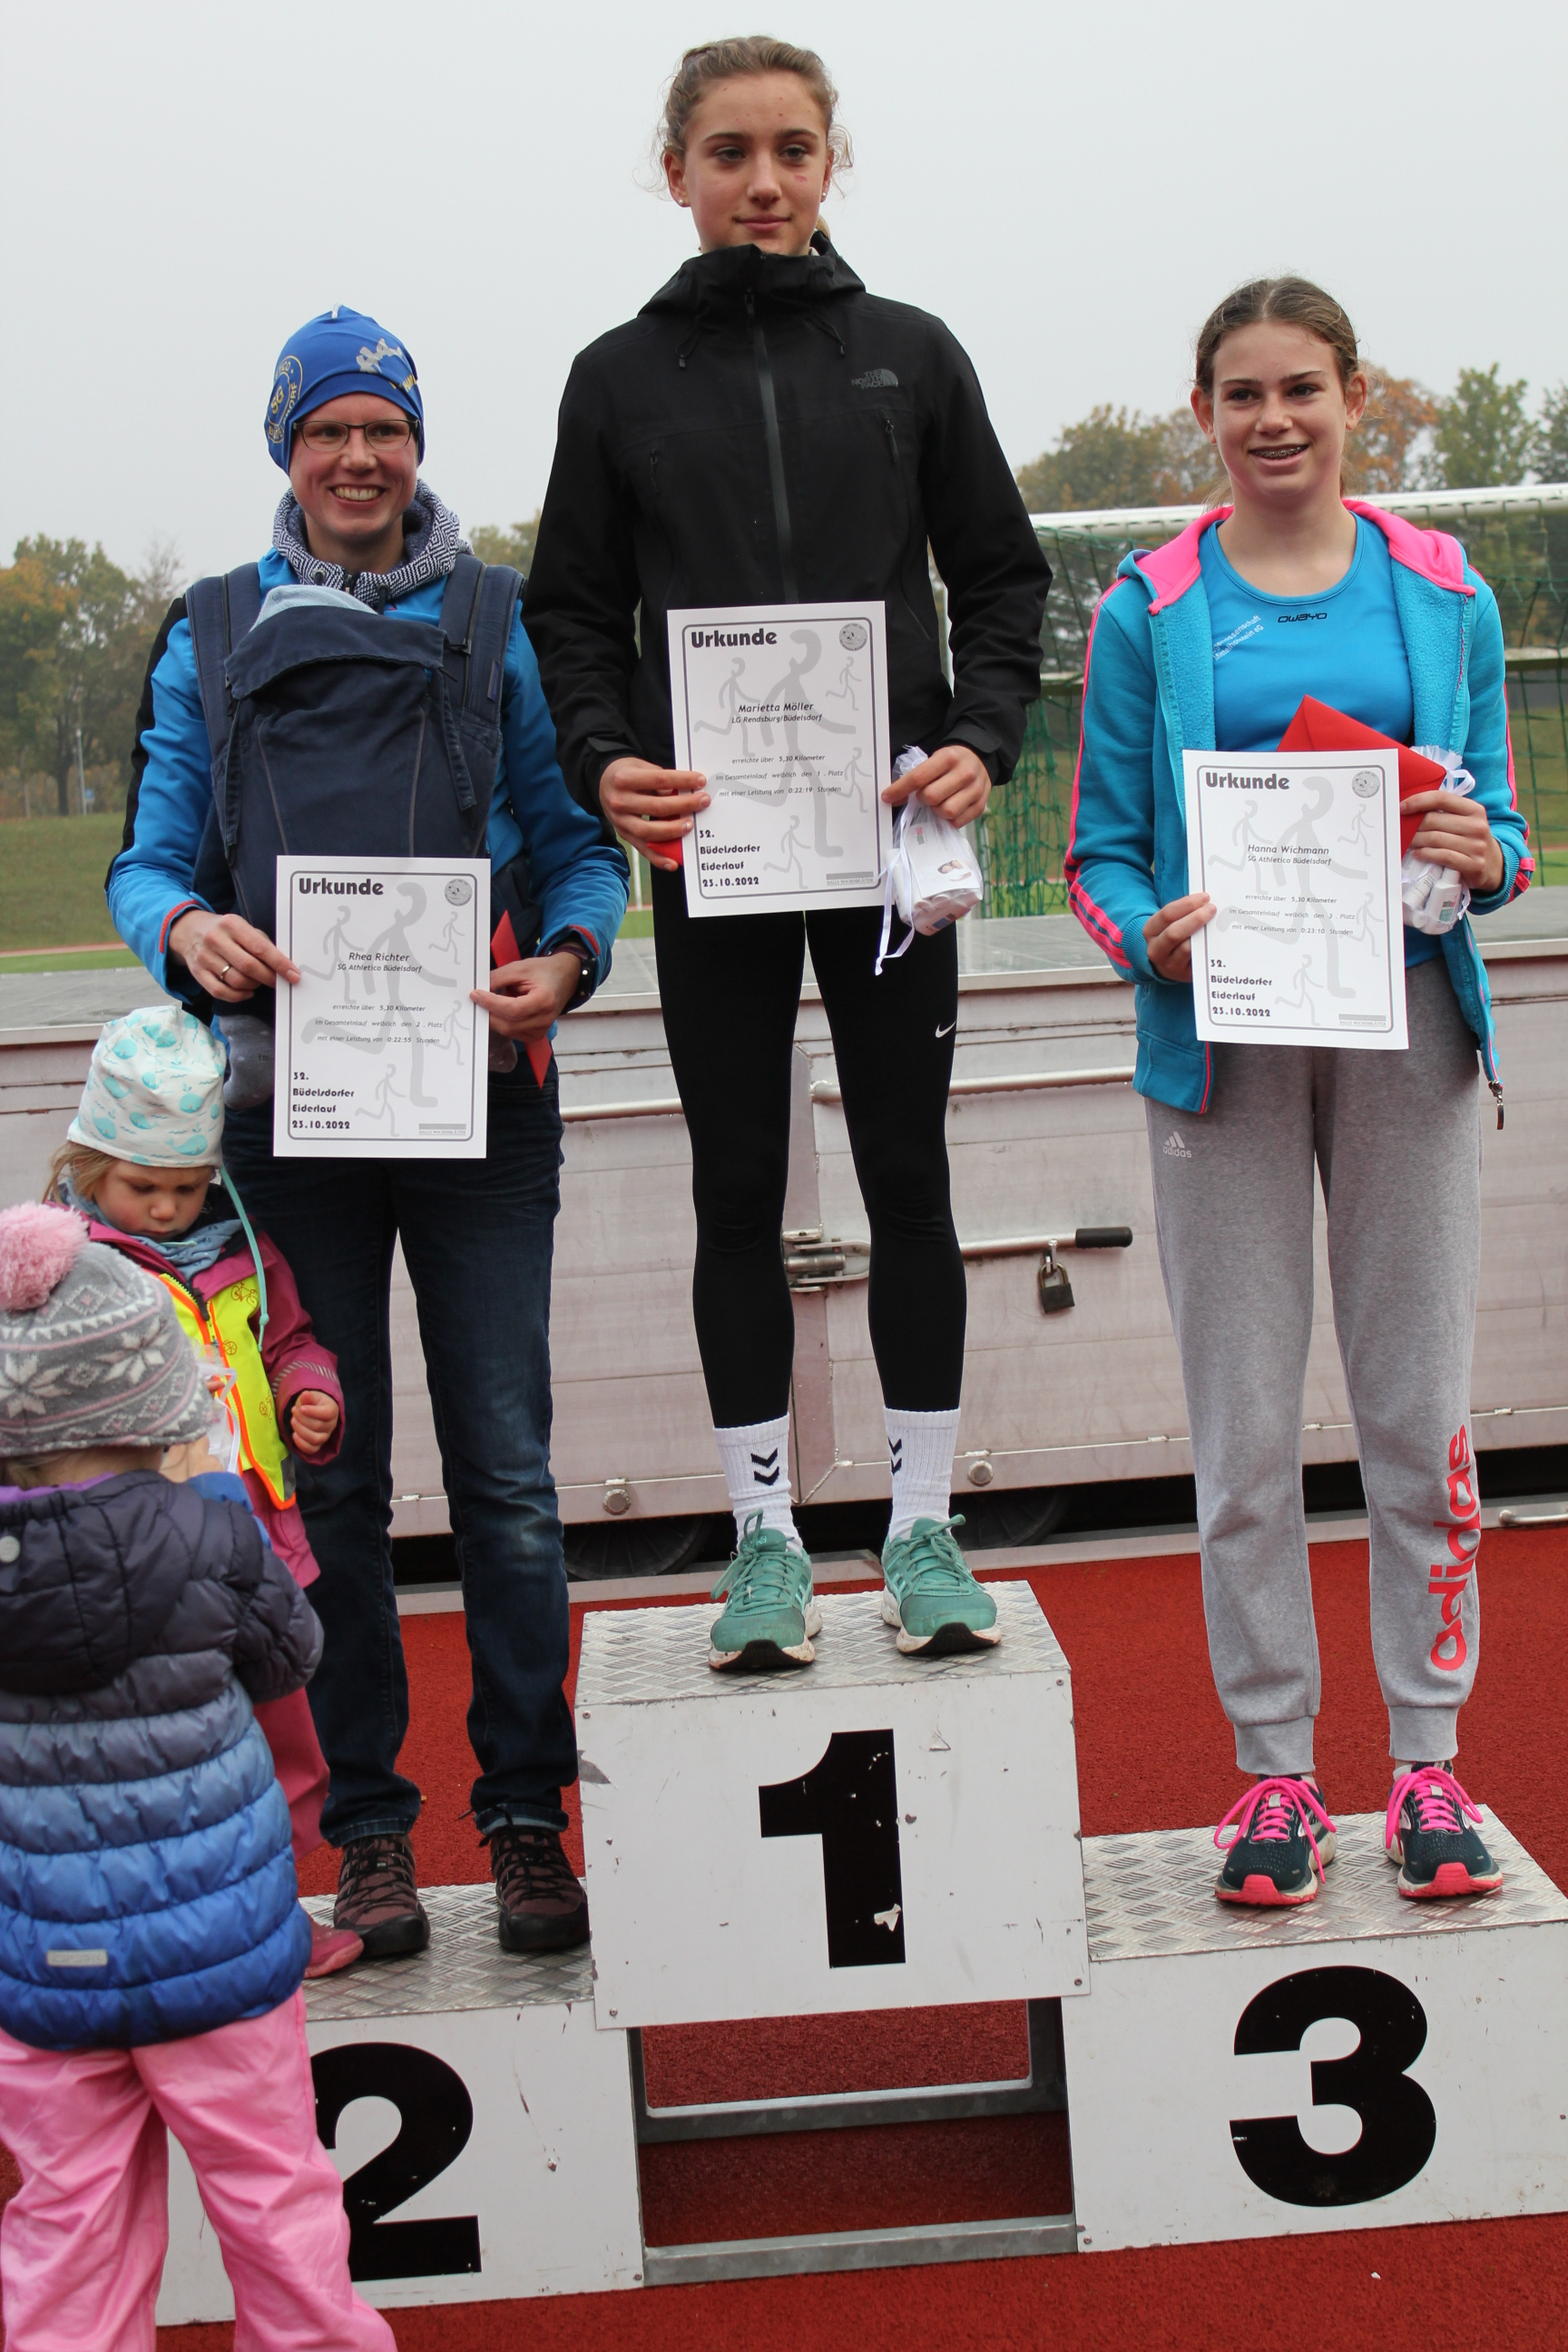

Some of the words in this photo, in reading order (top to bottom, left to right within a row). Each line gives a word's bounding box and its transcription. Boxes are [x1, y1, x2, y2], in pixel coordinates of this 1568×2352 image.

[861, 380, 885, 389] FACE
[270, 386, 285, 415] SG
[691, 628, 778, 648] Urkunde
[738, 704, 780, 713] Marietta
[783, 702, 814, 712] Möller
[743, 713, 823, 724] Rendsburg/Büdelsdorf
[779, 755, 794, 763] 5,30
[1206, 772, 1290, 789] Urkunde
[699, 829, 715, 838] 32.
[700, 844, 760, 855] Büdelsdorfer
[1248, 844, 1277, 853] Hanna
[1280, 846, 1329, 855] Wichmann
[701, 861, 744, 871] Eiderlauf
[1292, 857, 1332, 866] Büdelsdorf
[299, 877, 384, 896] Urkunde
[702, 877, 760, 887] 23.10.2022
[348, 953, 372, 961] Rhea
[376, 953, 410, 962] Richter
[1210, 959, 1226, 968] 32.
[383, 965, 423, 974] Büdelsdorf
[1210, 975, 1272, 986] Büdelsdorfer
[1211, 991, 1256, 1001] Eiderlauf
[1212, 1006, 1271, 1017] 23.10.2022
[293, 1072, 309, 1081] 32.
[292, 1088, 355, 1097] Büdelsdorfer
[292, 1103, 337, 1113] Eiderlauf
[292, 1120, 350, 1130] 23.10.2022
[1163, 1146, 1192, 1158] adidas
[1428, 1424, 1481, 1671] adidas
[759, 1729, 906, 1969] 1
[1230, 1965, 1436, 2208] 3
[309, 2042, 483, 2282] 2
